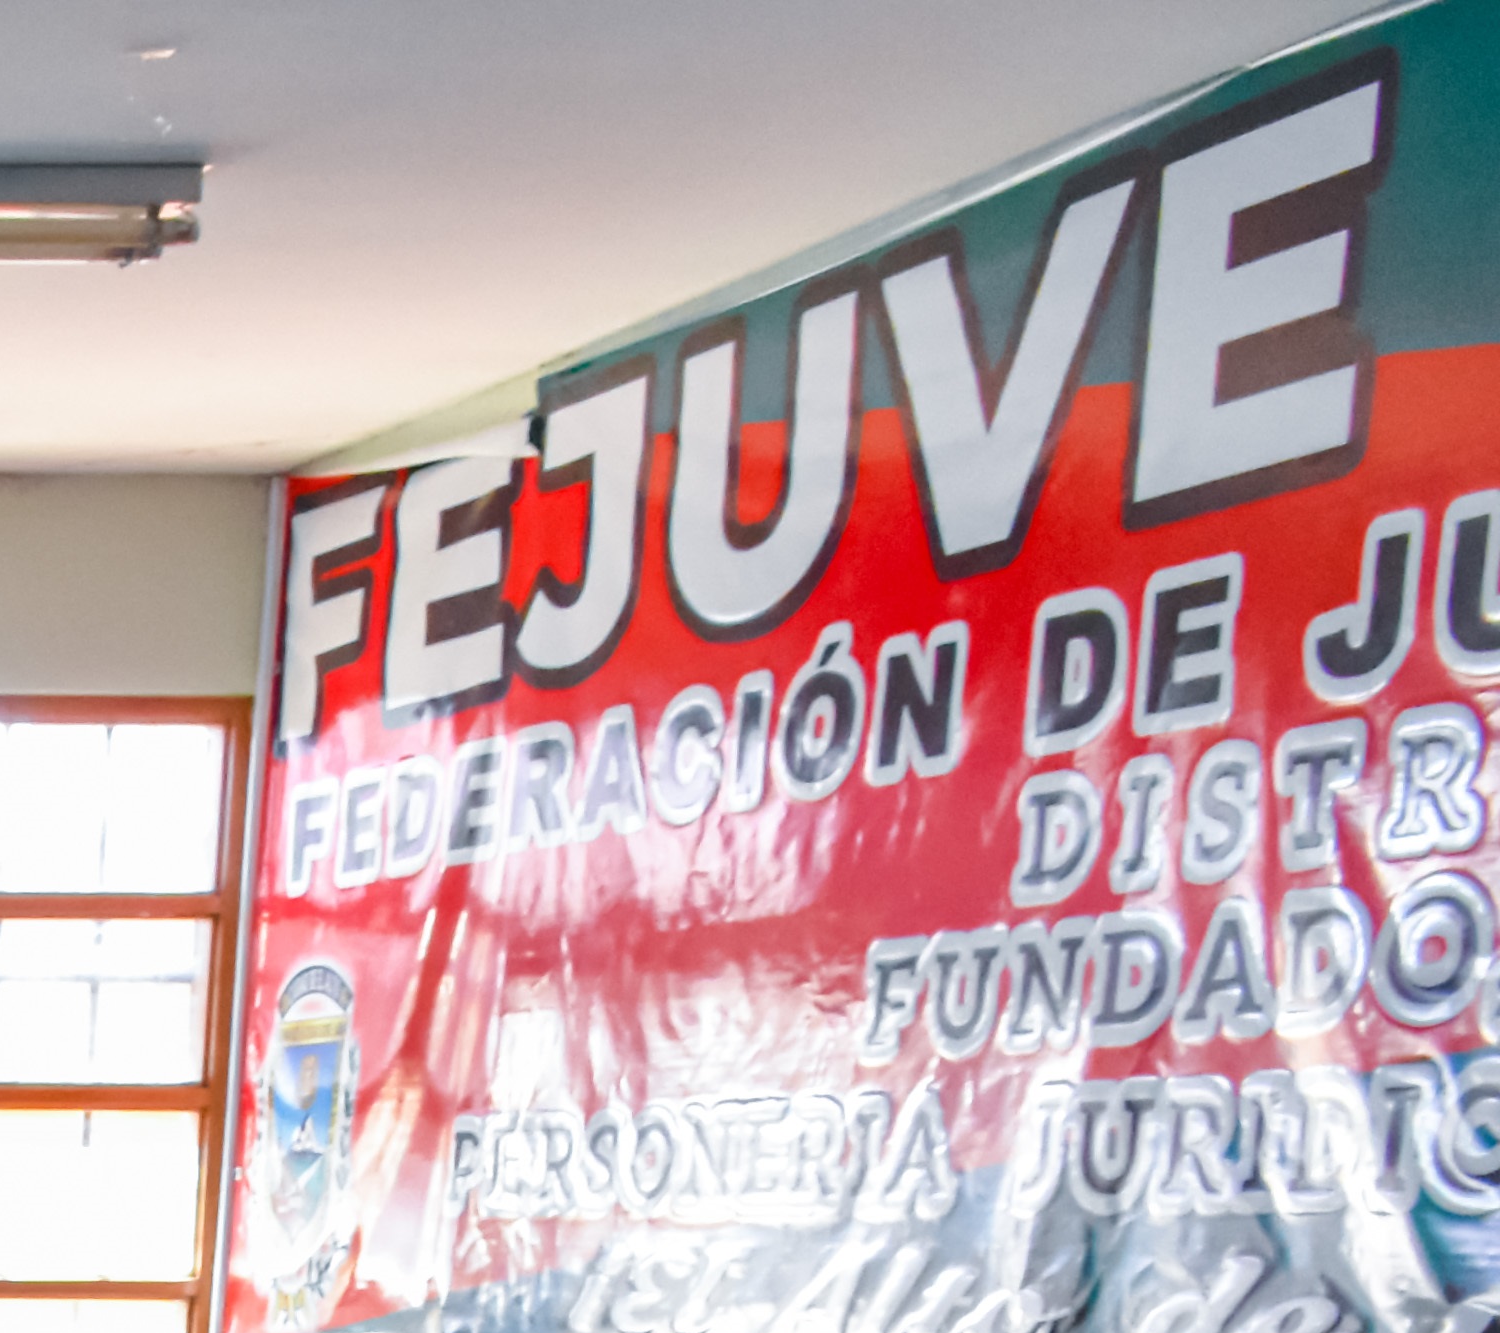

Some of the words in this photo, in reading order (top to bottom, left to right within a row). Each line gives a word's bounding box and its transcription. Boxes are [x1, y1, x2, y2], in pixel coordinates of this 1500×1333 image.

[278, 48, 1397, 752] FEJUVE
[288, 622, 968, 894] FEDERACIÓN
[1023, 551, 1244, 758] DE
[1009, 701, 1488, 906] DISTR
[862, 868, 1500, 1068] FUNDADO
[446, 1058, 959, 1228] PERSONERIA
